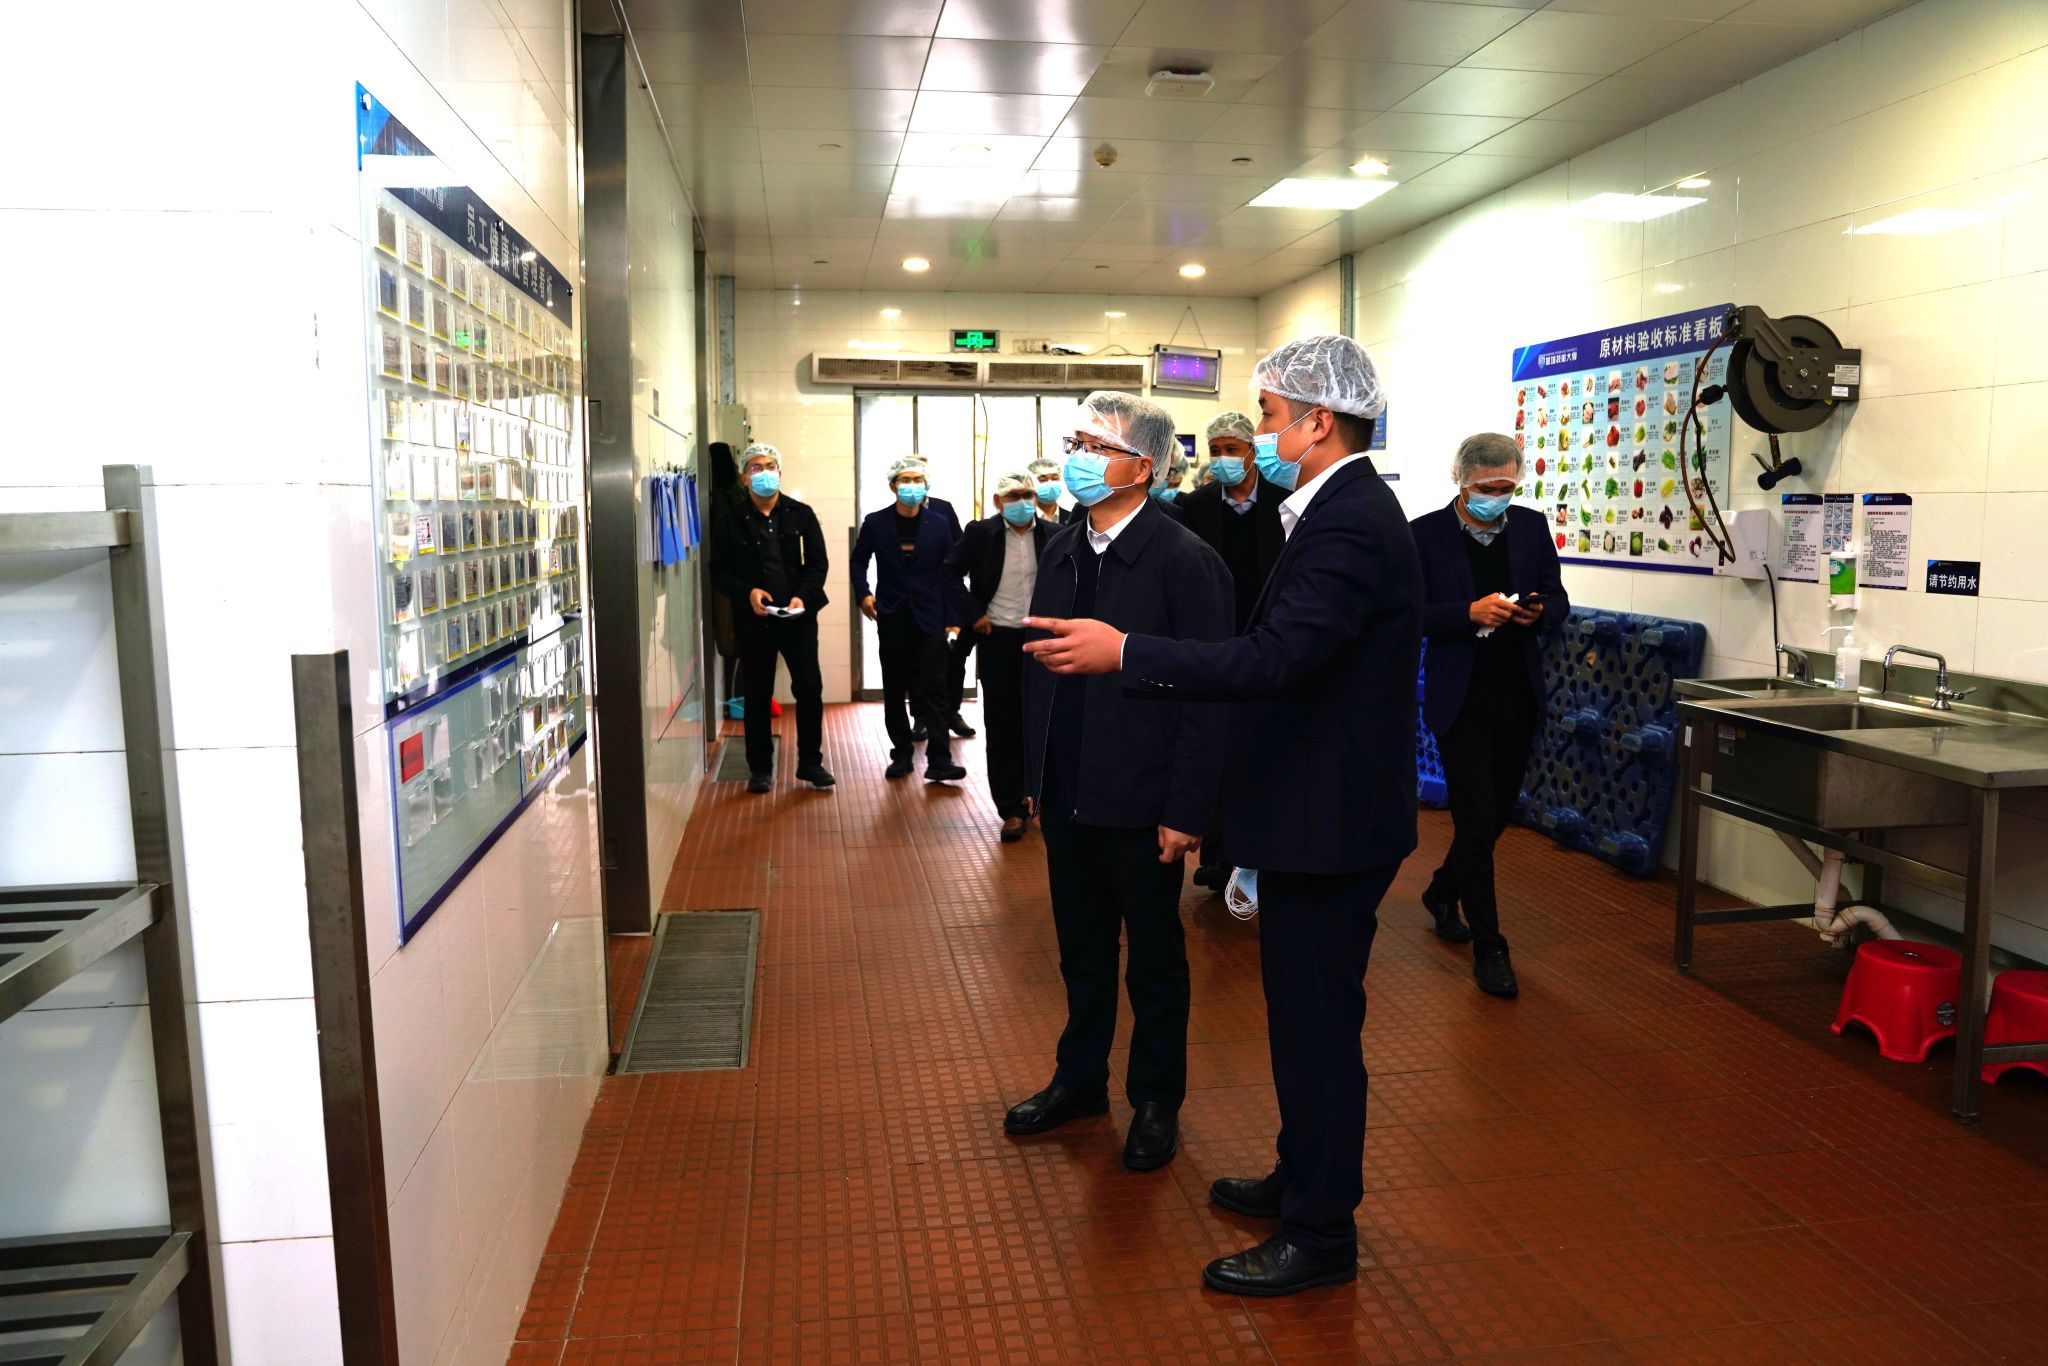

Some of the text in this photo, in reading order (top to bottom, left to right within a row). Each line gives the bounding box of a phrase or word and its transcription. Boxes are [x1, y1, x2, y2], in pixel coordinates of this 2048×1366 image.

[1599, 315, 1723, 359] 原材料验收标准看板
[1929, 574, 1977, 590] 请节约用水
